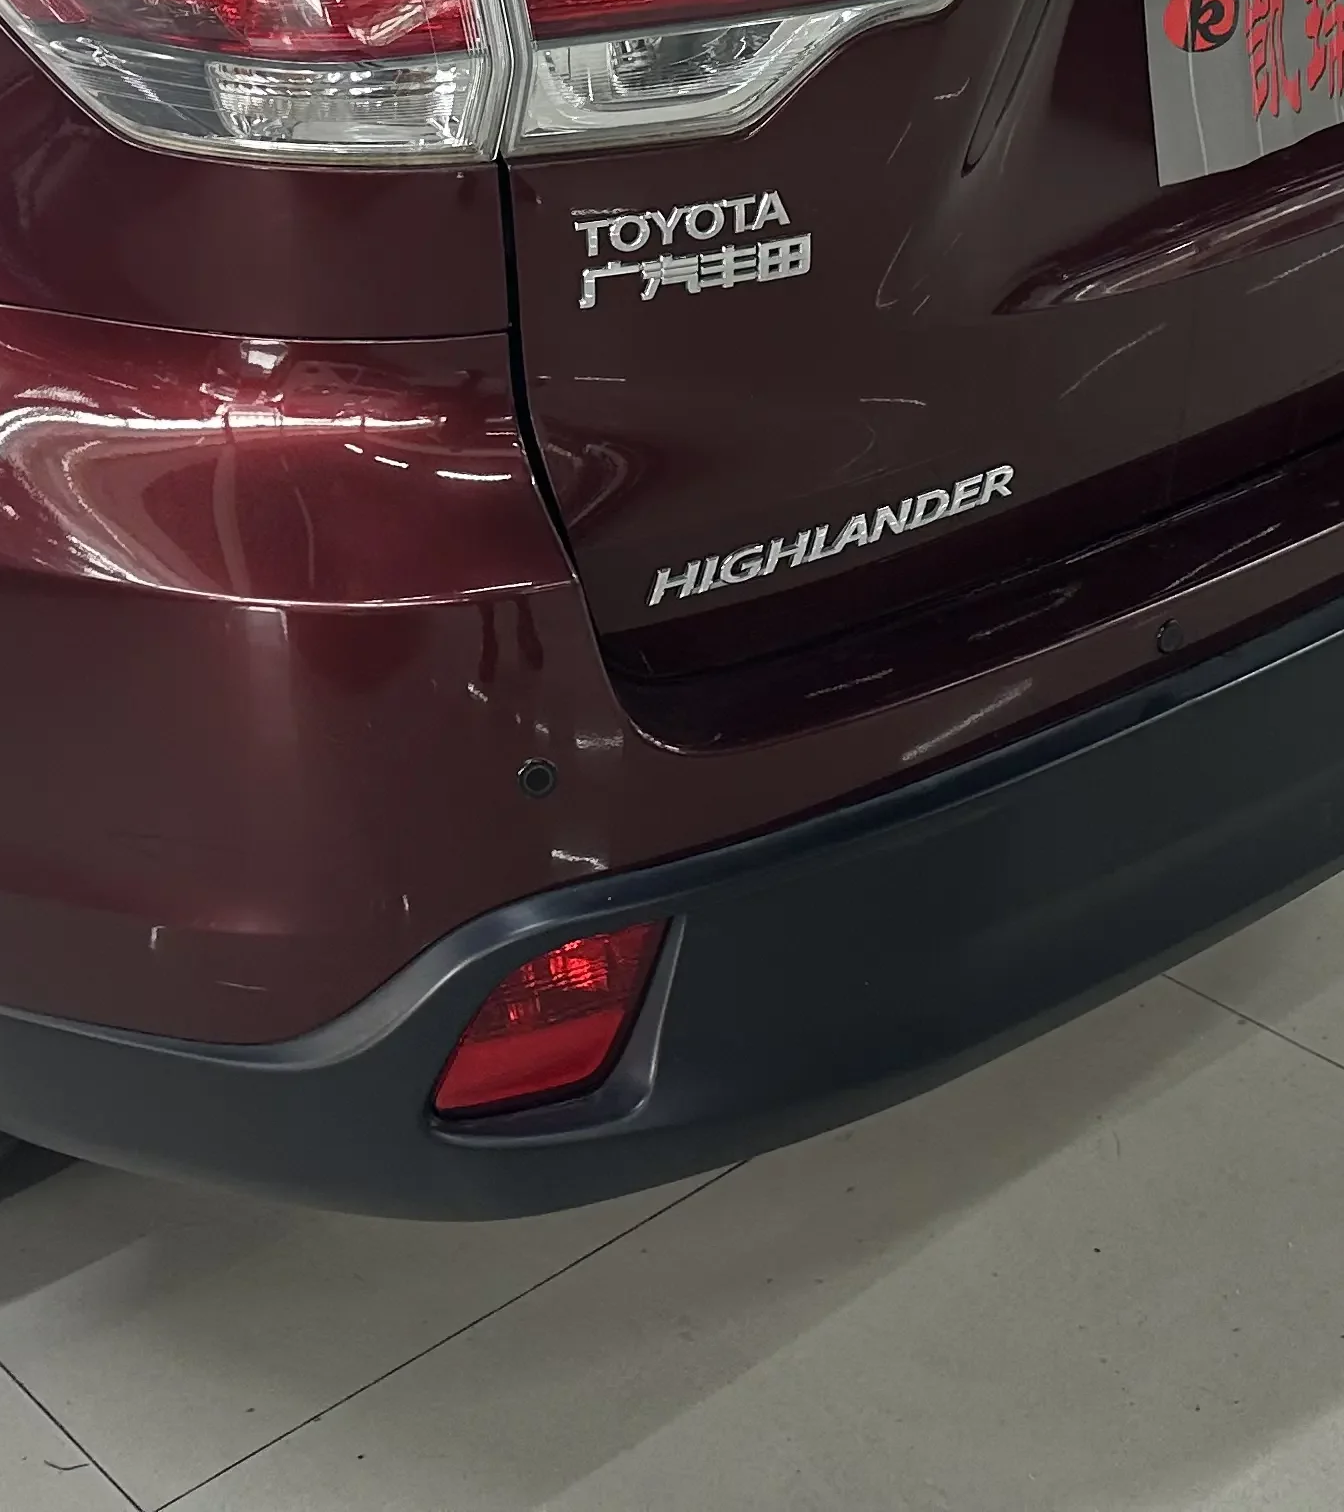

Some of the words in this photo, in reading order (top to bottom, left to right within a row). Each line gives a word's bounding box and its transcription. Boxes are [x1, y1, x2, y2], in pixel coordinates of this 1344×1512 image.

[573, 190, 792, 257] TOYOTA
[578, 233, 812, 309] 广汽丰田
[645, 465, 1015, 606] HIGHLANDER
